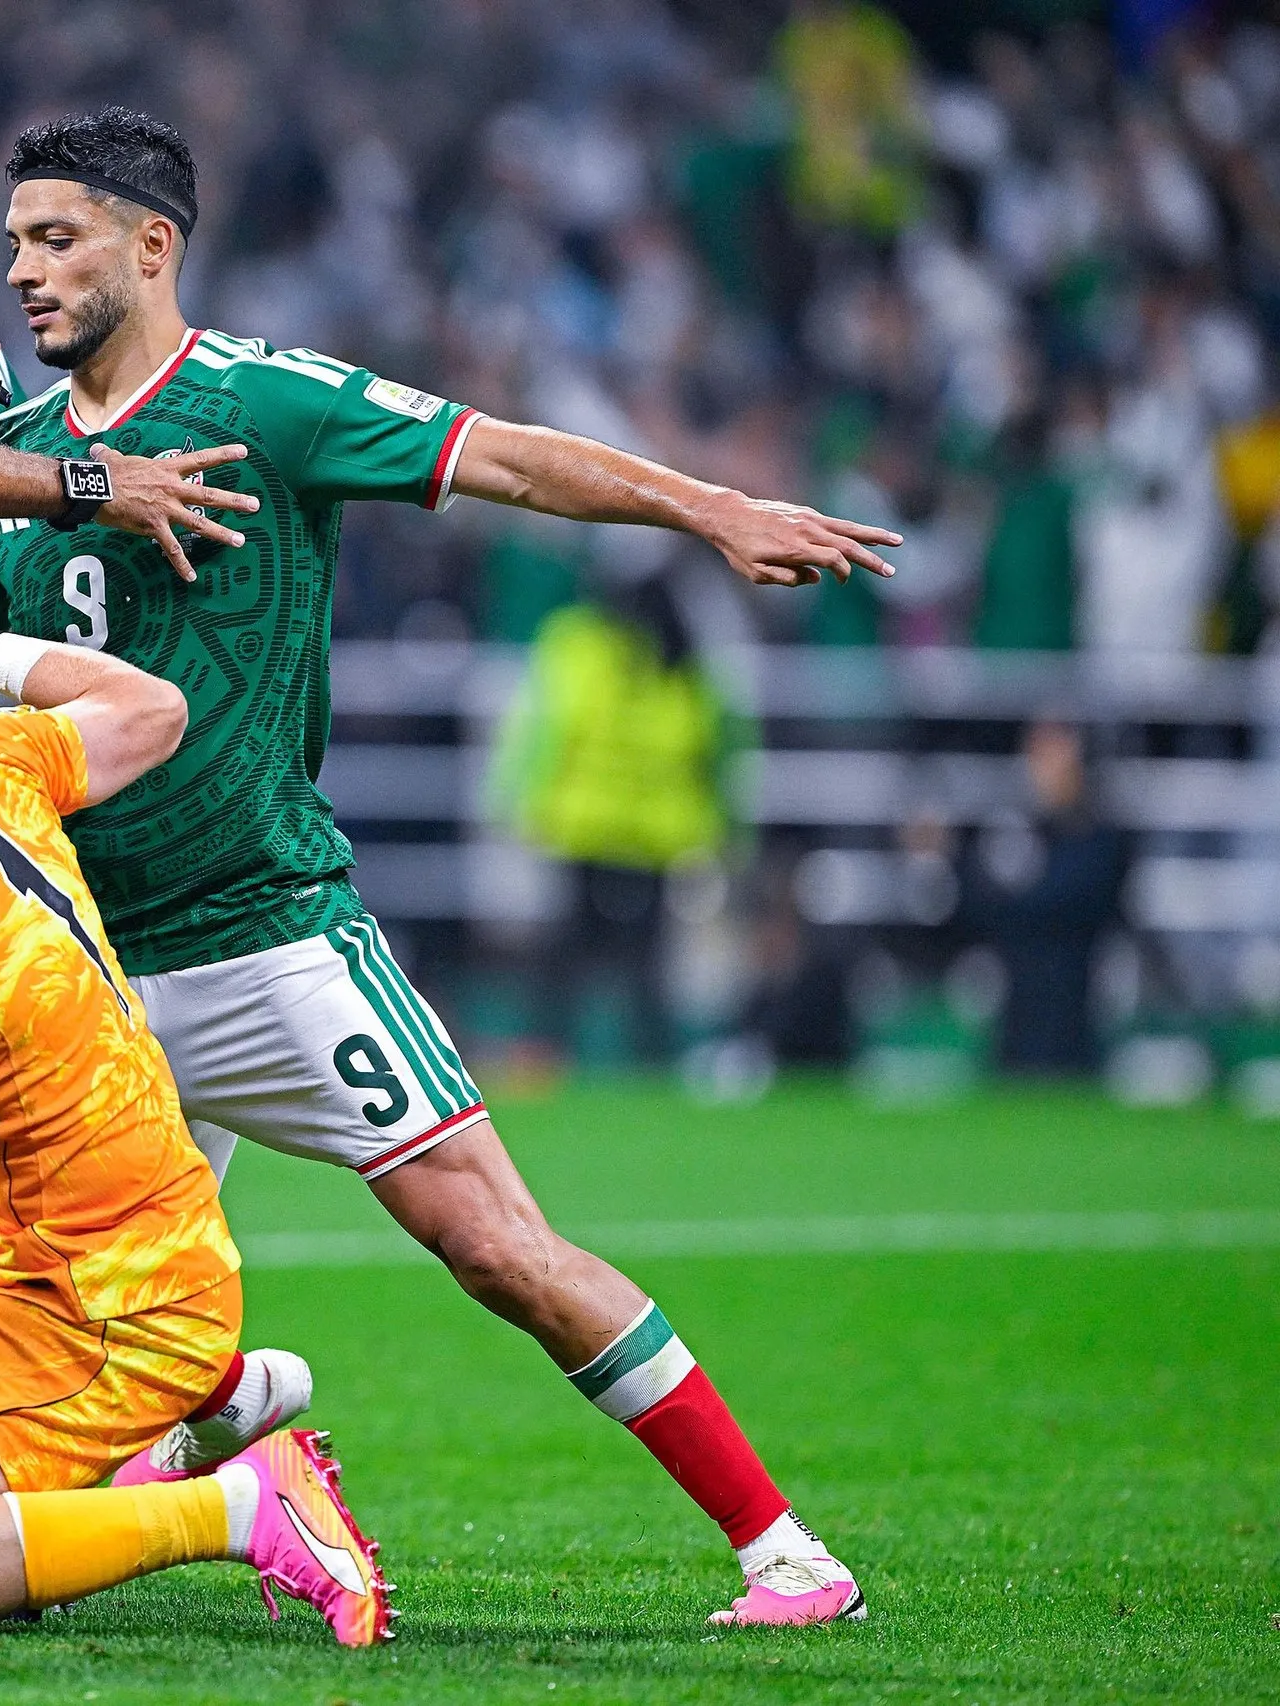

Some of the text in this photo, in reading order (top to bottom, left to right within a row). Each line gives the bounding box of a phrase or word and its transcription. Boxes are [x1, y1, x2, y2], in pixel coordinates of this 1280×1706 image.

[71, 472, 106, 493] 68:47
[63, 554, 109, 652] 9
[333, 1033, 410, 1128] 9
